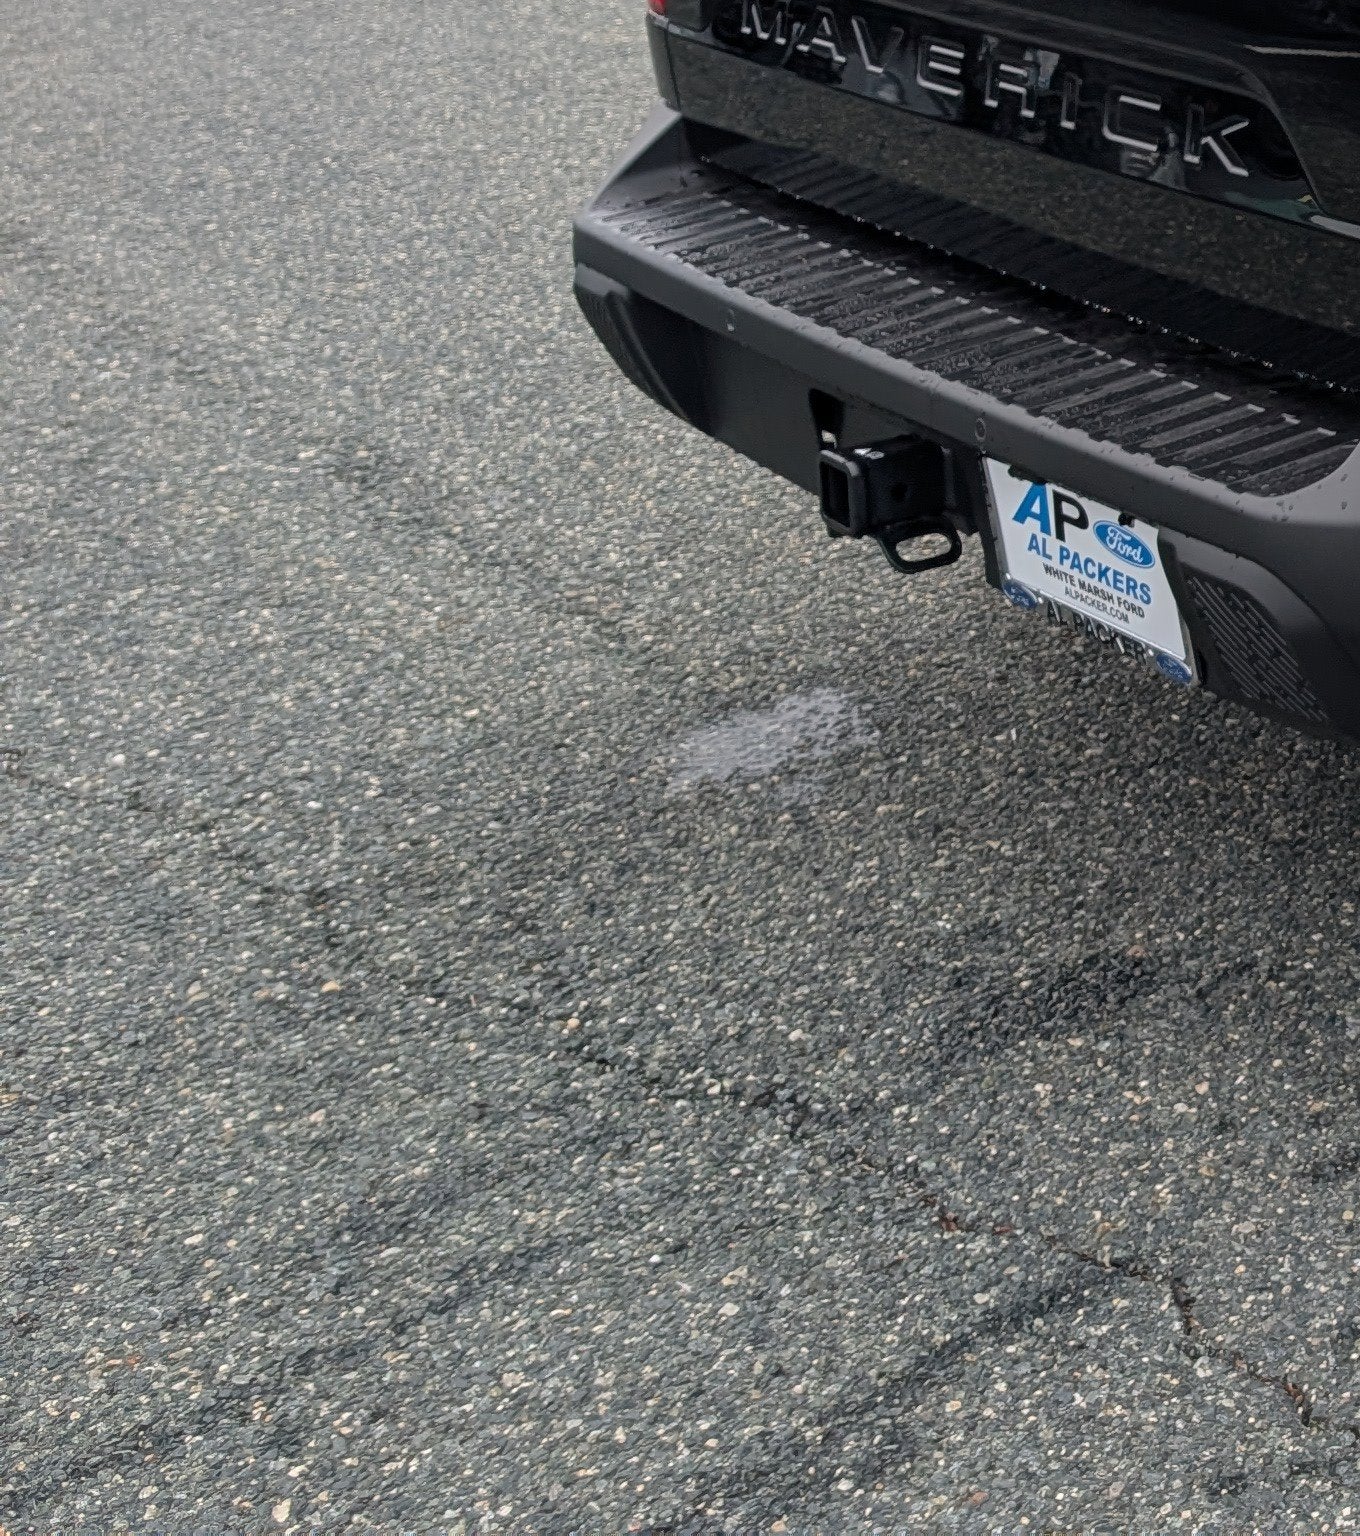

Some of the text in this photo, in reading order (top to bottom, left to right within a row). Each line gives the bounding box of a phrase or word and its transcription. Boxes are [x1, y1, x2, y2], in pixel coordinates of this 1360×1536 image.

[1011, 481, 1090, 543] AP
[1027, 533, 1152, 605] AL PACKERS
[1105, 525, 1144, 564] Ford
[1042, 562, 1145, 619] WHITE MARSH FORD
[1064, 586, 1130, 625] ALPACKER.COM
